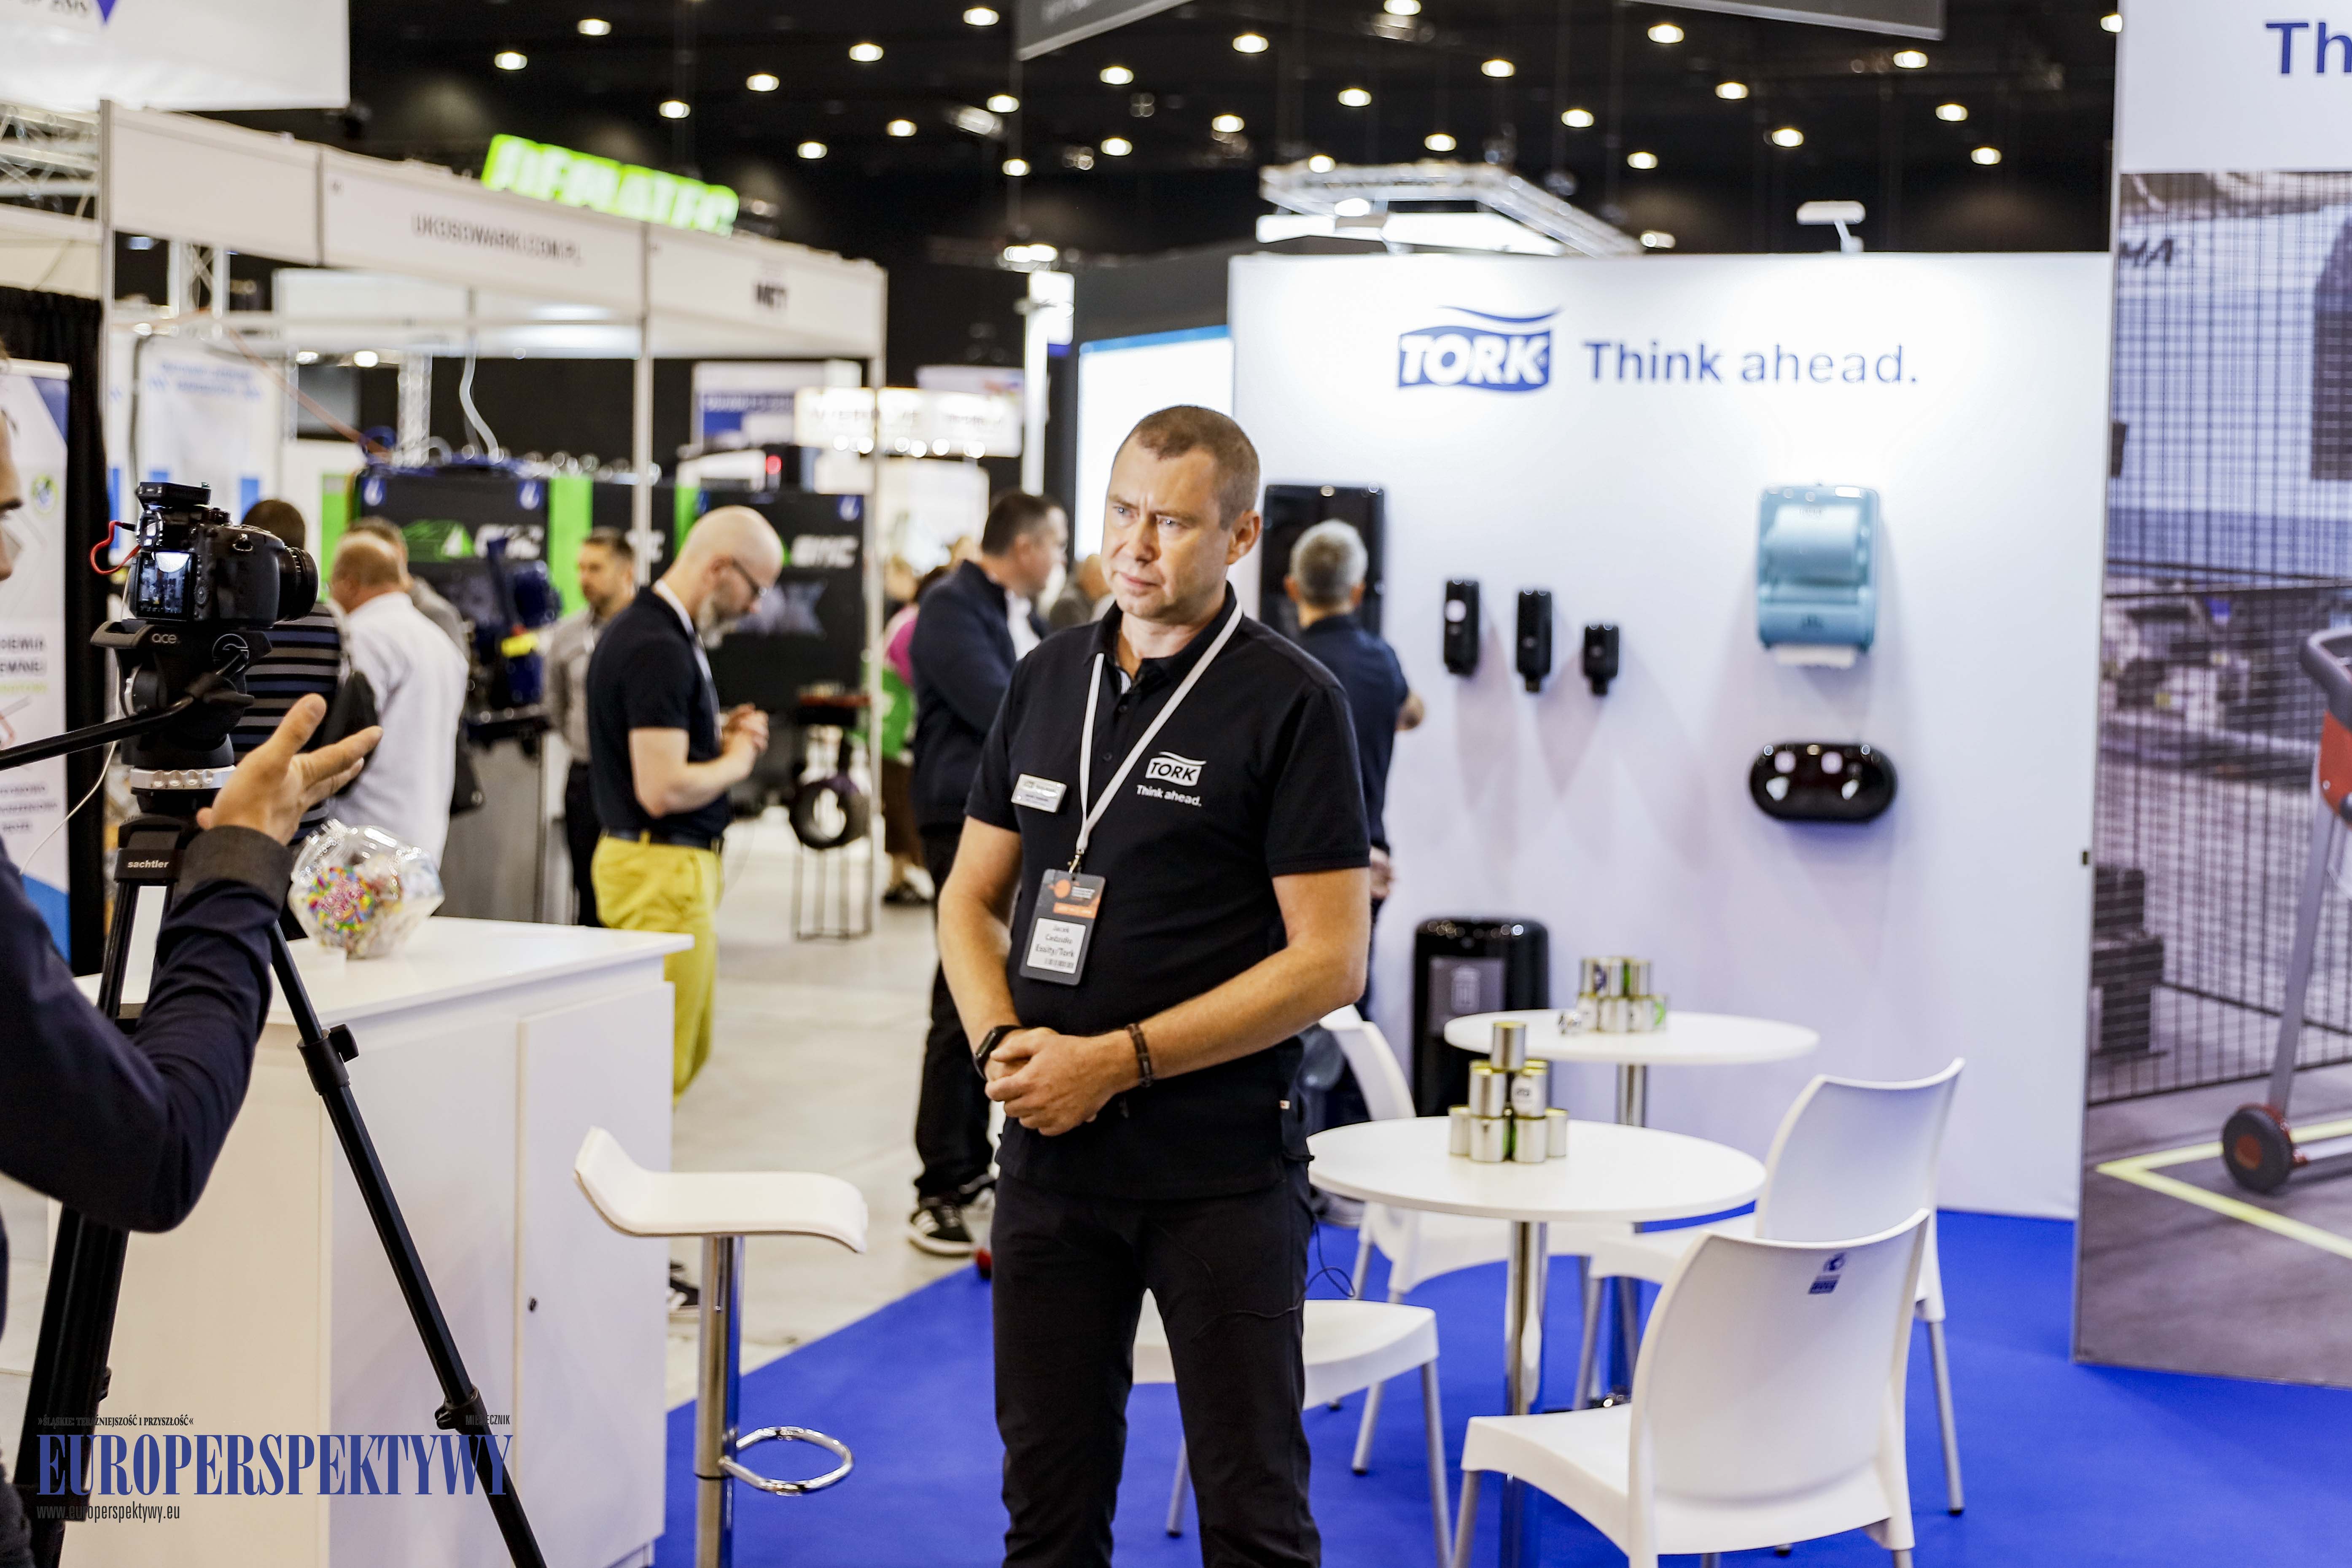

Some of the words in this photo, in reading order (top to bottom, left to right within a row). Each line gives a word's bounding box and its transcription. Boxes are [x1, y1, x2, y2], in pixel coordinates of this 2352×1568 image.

[2265, 23, 2352, 75] Th
[1400, 334, 1549, 385] TORK
[1583, 341, 1722, 383] Think
[1741, 342, 1916, 384] ahead.
[152, 633, 177, 644] ace
[1151, 762, 1196, 781] TORK
[1137, 784, 1163, 799] Think
[1164, 790, 1202, 807] ahead.
[128, 860, 169, 868] sachtler
